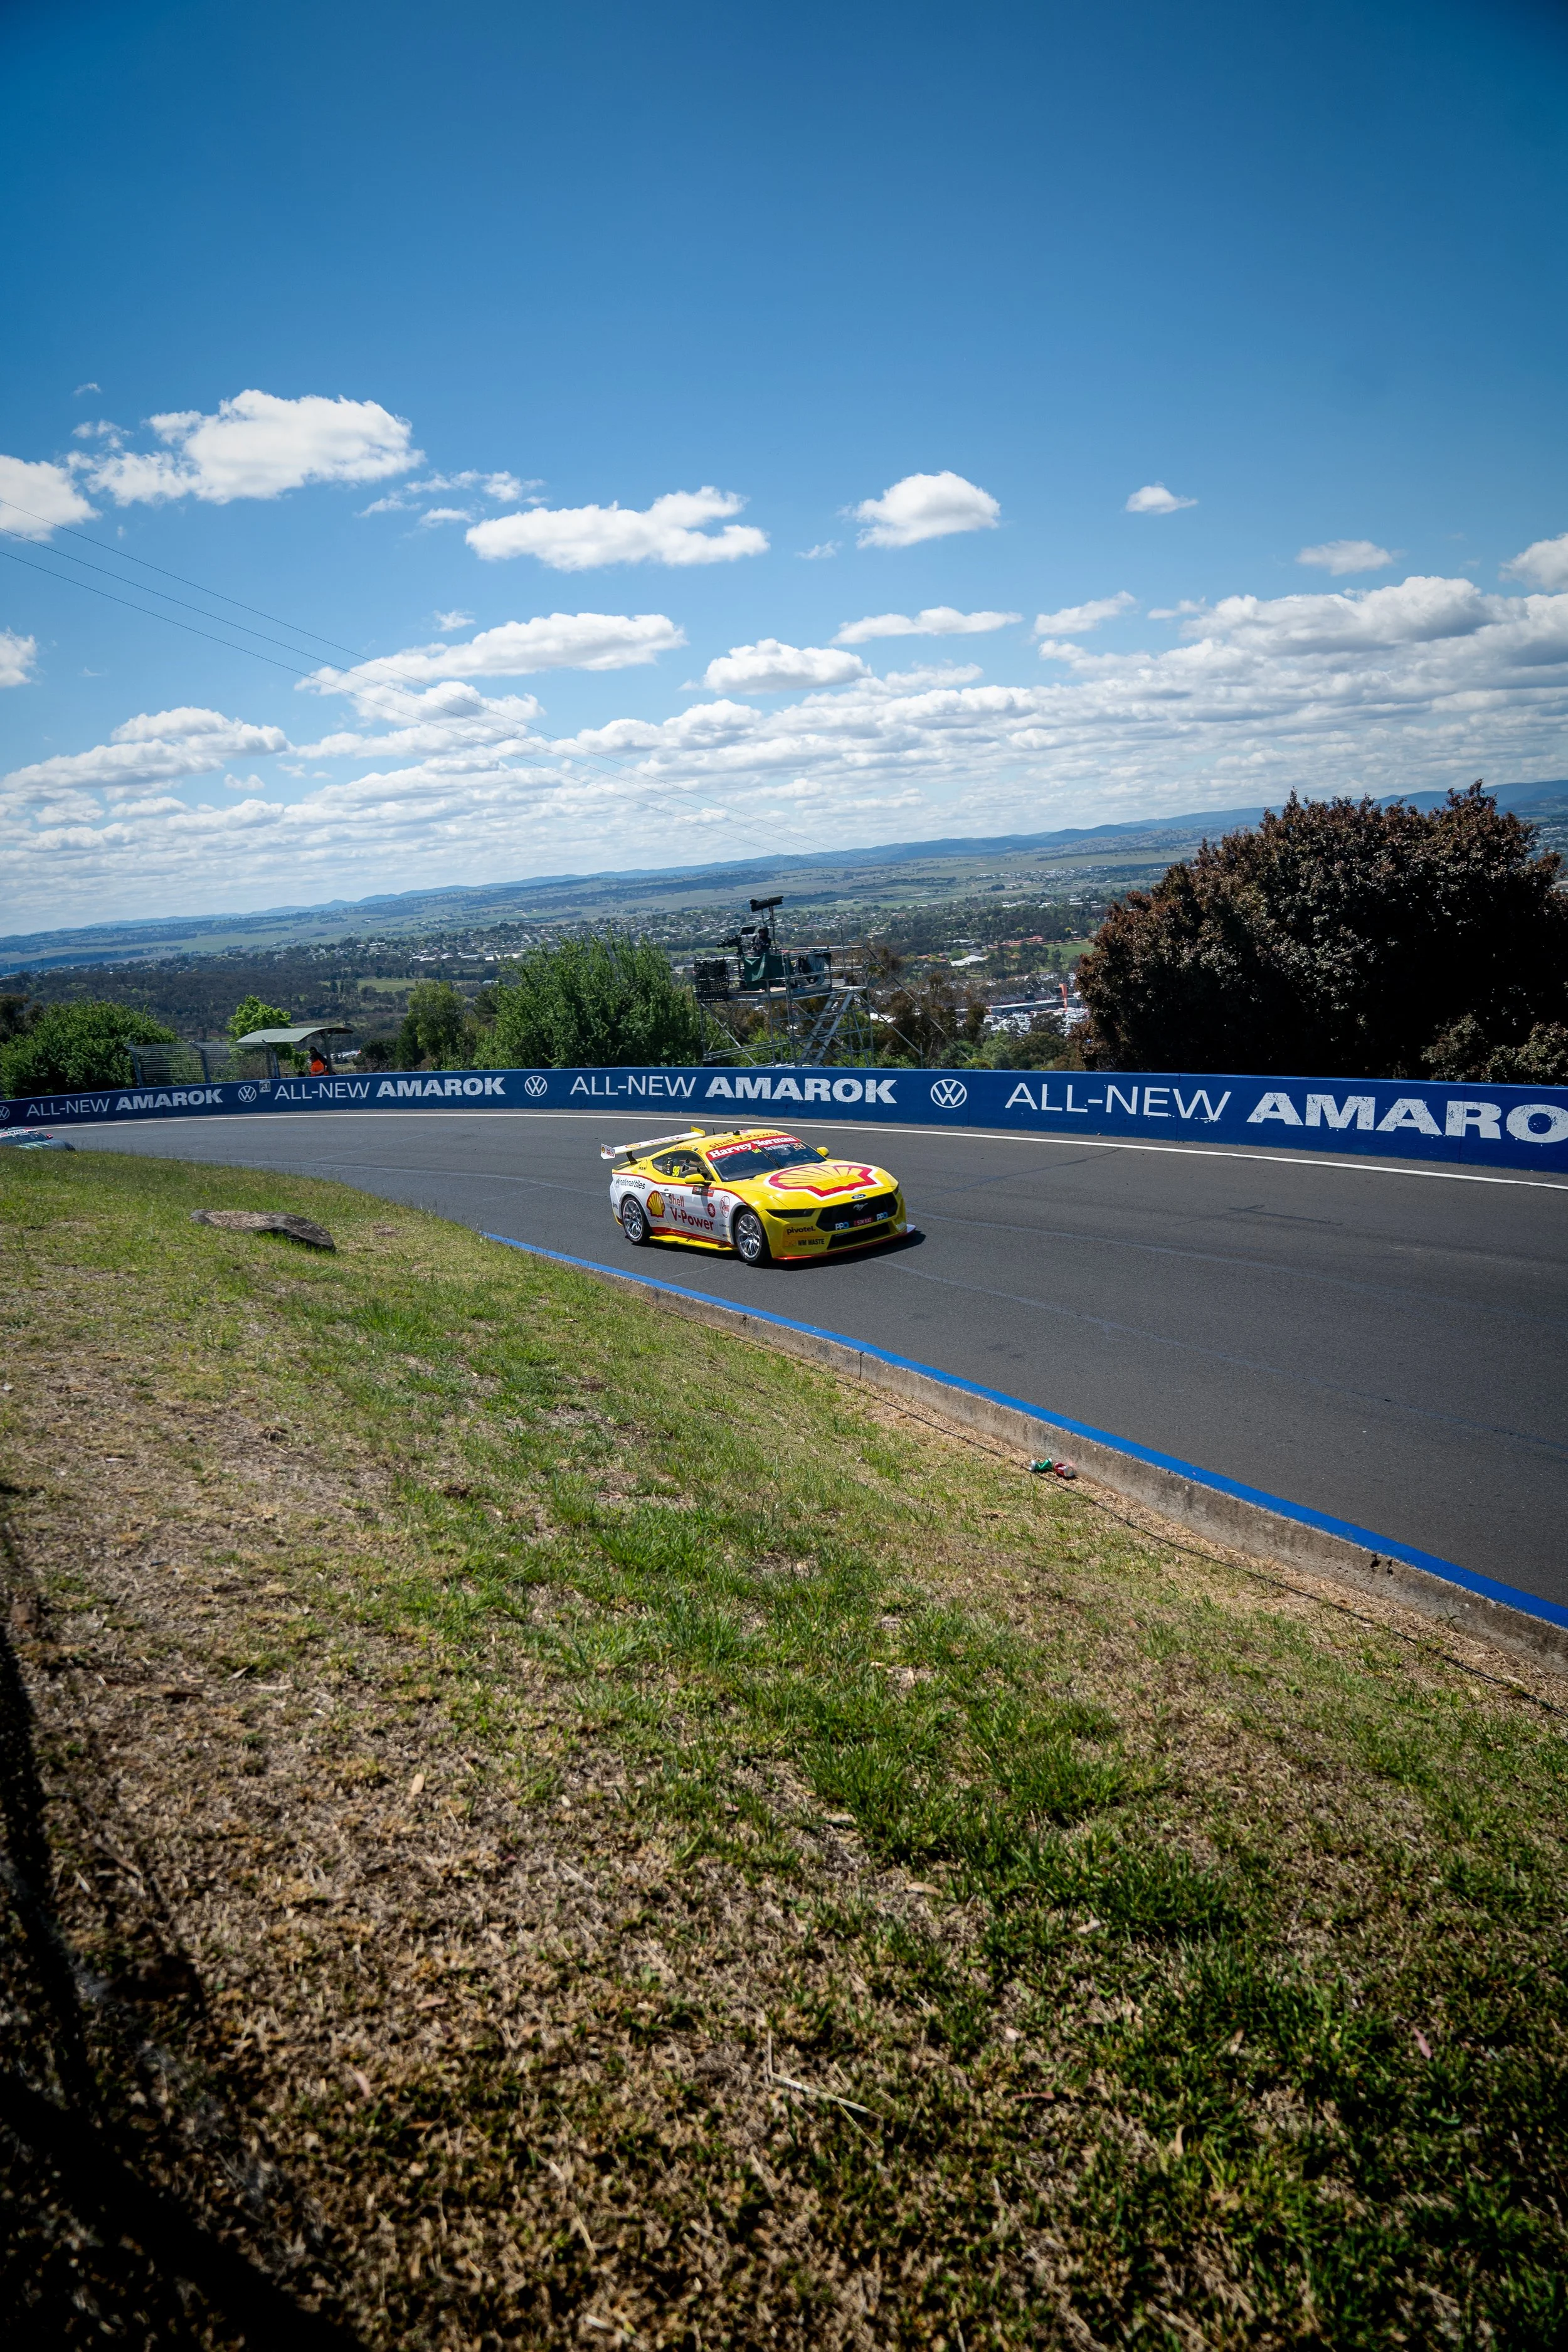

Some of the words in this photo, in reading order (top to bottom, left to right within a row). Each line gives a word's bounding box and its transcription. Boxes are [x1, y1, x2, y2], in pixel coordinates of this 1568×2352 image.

[275, 1082, 370, 1100] ALL-NEW
[377, 1077, 506, 1098] AMAROK
[569, 1076, 696, 1098] ALL-NEW
[705, 1077, 897, 1104] AMAROK
[26, 1098, 110, 1117] ALL-NEW
[115, 1089, 223, 1111] AMAROK
[1005, 1083, 1232, 1122] ALL-NEW
[1246, 1092, 1568, 1143] AMARO
[709, 1139, 734, 1148] Shell
[736, 1132, 779, 1140] V-Power
[709, 1143, 751, 1158] Harvey
[751, 1137, 797, 1147] Norman
[672, 1165, 680, 1177] 98
[633, 1180, 646, 1190] tiles
[669, 1193, 685, 1207] Shell
[670, 1207, 714, 1231] V-Power
